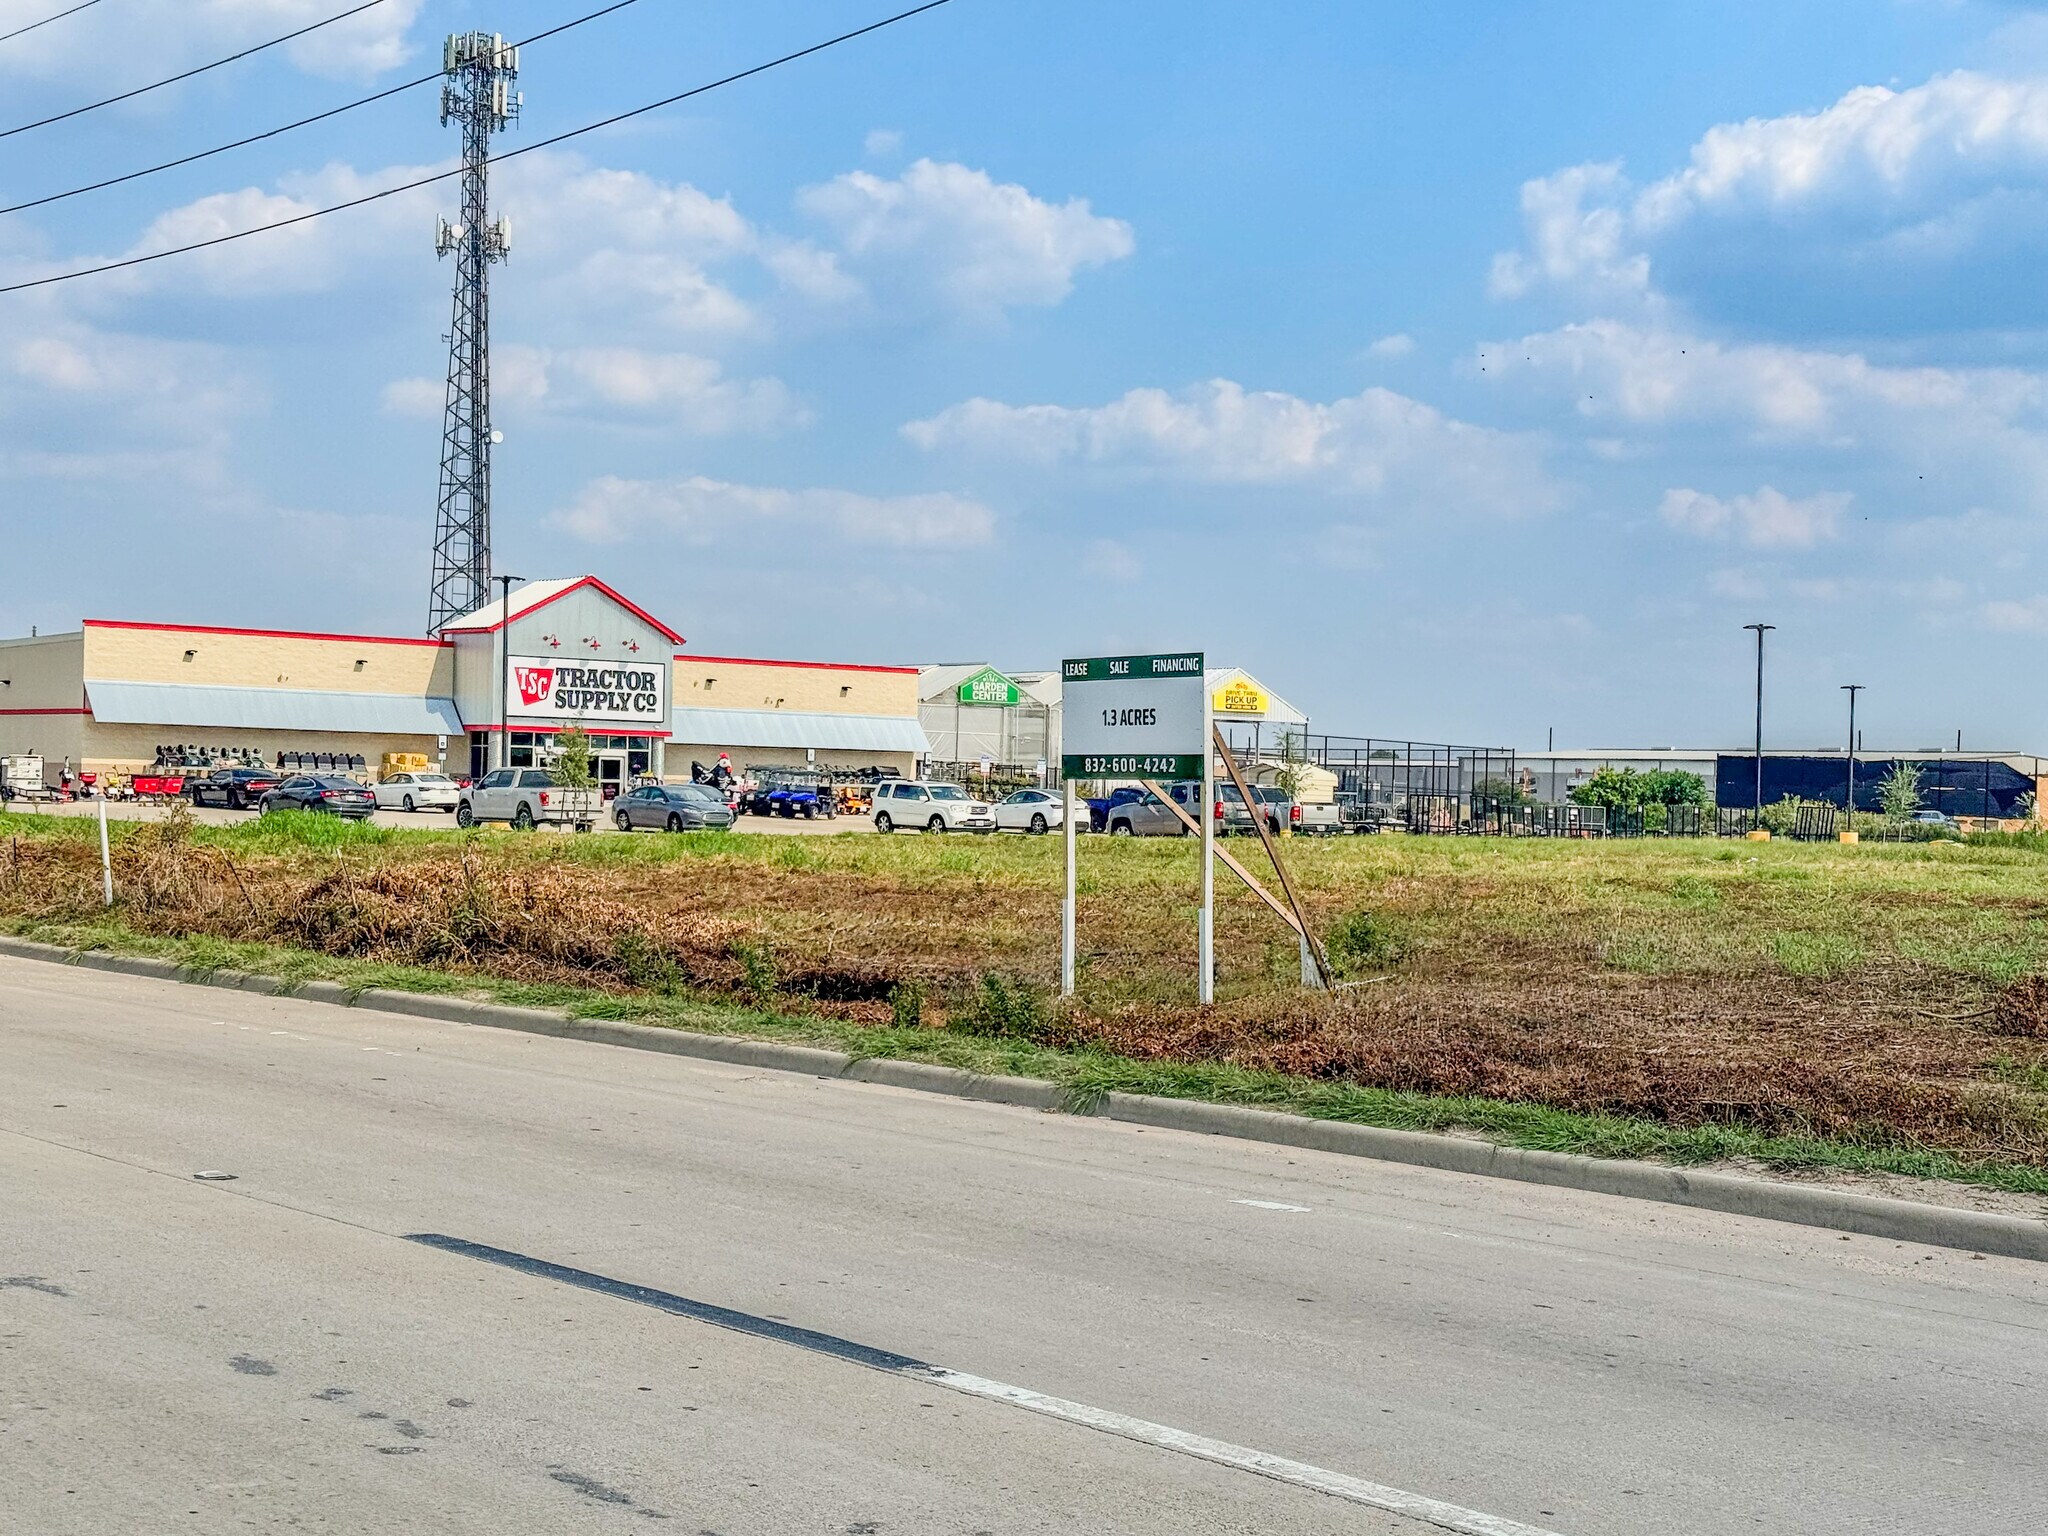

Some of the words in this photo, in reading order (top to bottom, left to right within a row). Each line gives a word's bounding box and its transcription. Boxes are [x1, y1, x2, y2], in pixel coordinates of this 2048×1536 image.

[1065, 663, 1088, 676] LEASE
[1109, 661, 1129, 674] SALE
[1152, 658, 1199, 672] FINANCING
[518, 668, 548, 700] TSC
[555, 667, 657, 691] TRACTOR
[972, 681, 1008, 692] GARDEN
[555, 689, 632, 712] SUPPLY
[972, 690, 1008, 701] CENTER
[1225, 695, 1244, 703] PICK
[1246, 696, 1257, 704] UP
[1102, 709, 1117, 727] 1.3
[1120, 708, 1156, 726] ACRES
[1084, 757, 1176, 773] 832-600-4242
